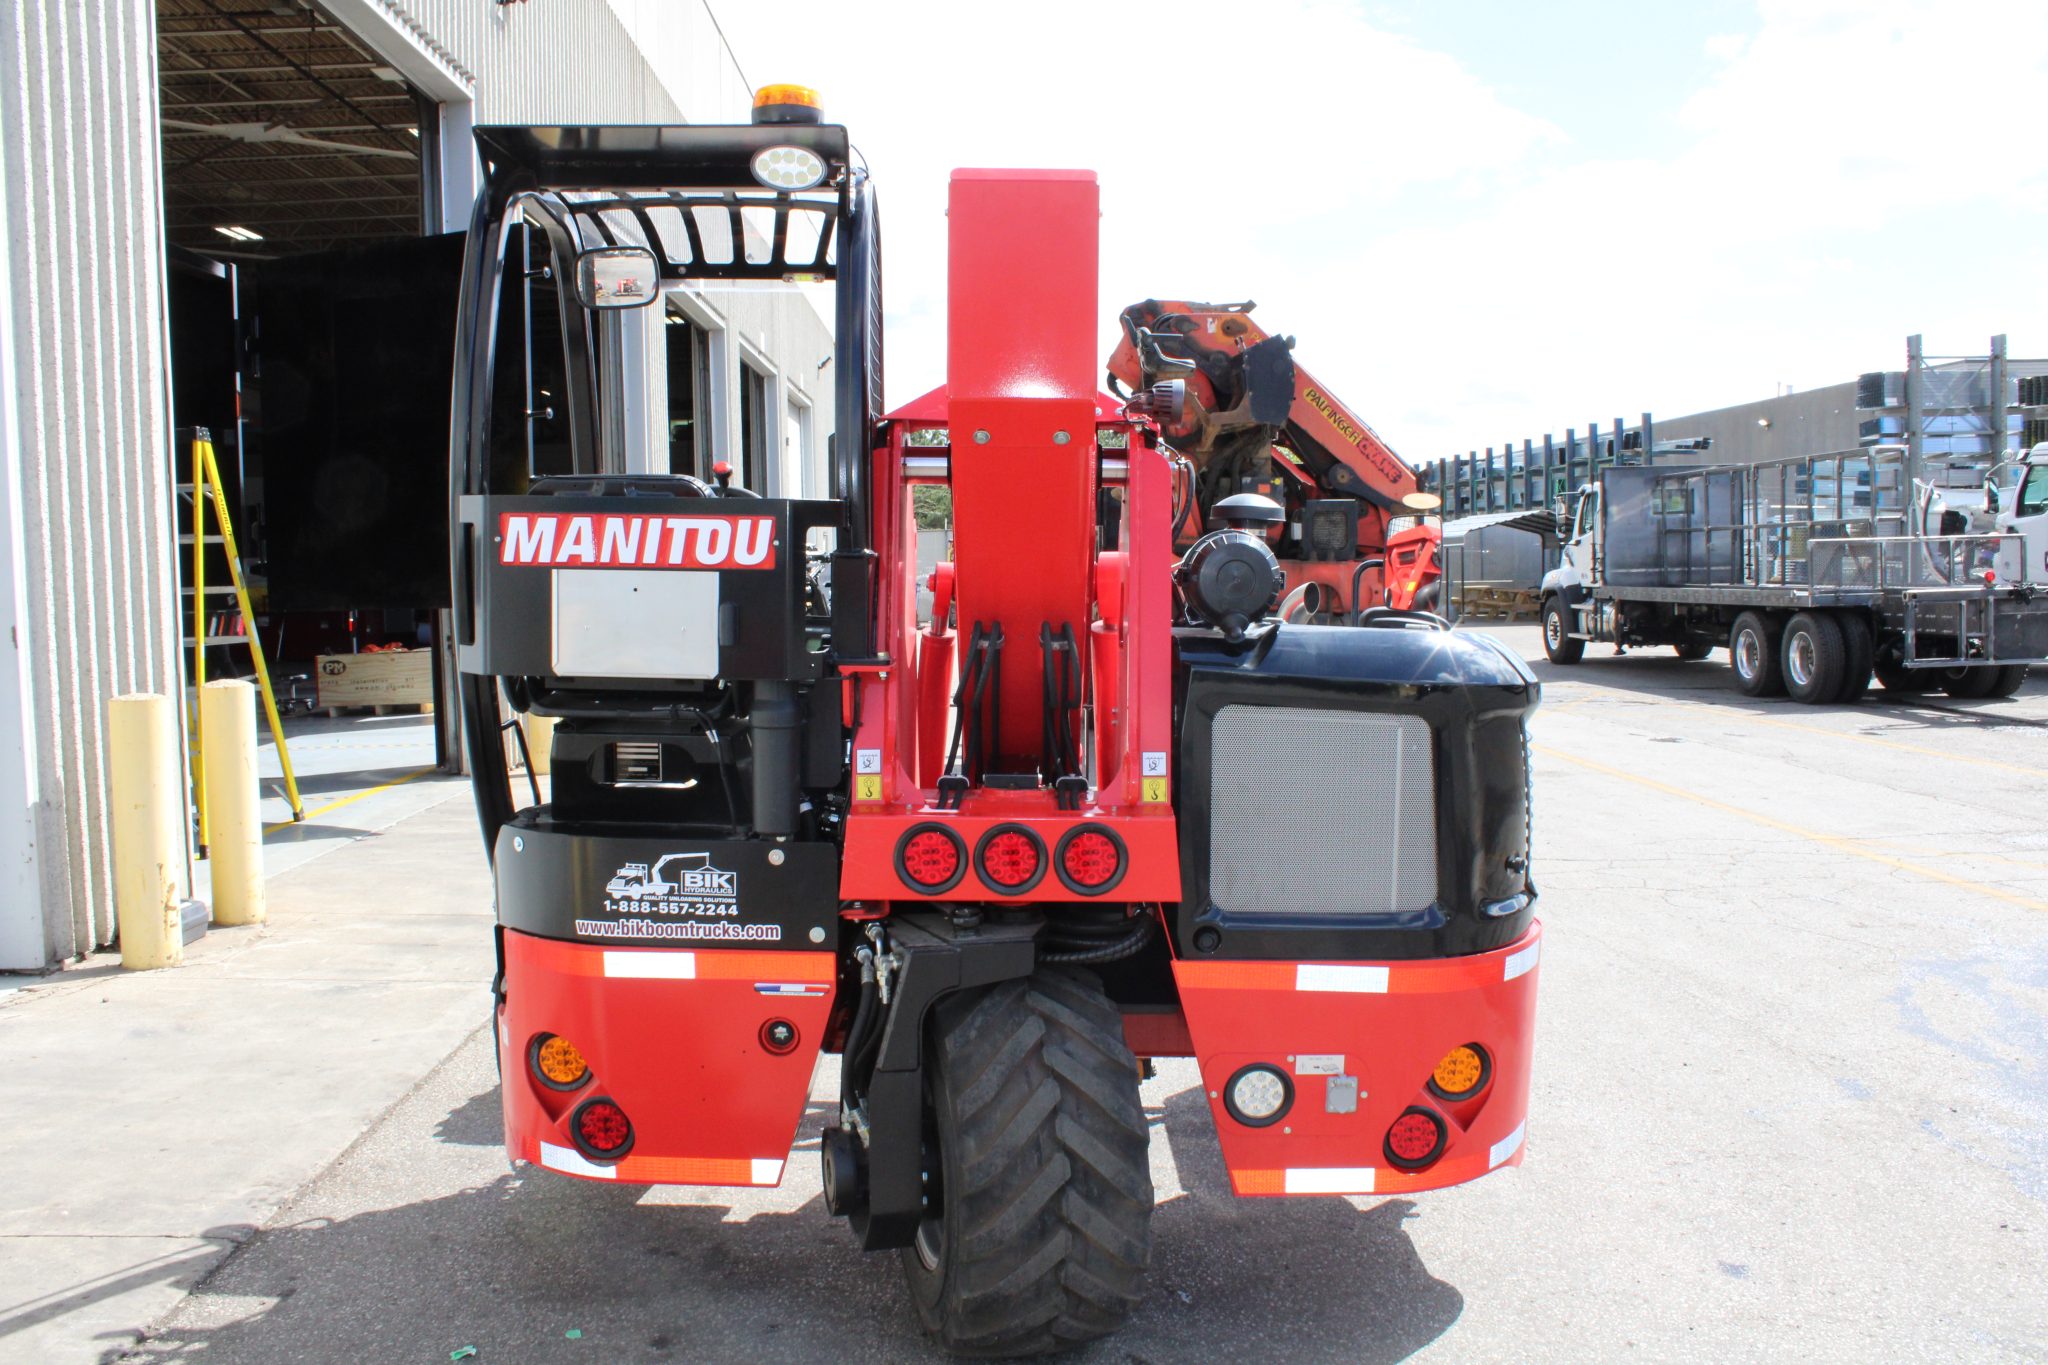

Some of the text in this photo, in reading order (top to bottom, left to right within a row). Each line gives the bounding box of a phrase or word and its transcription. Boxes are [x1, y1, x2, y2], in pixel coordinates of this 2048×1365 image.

[1305, 388, 1361, 446] PALFINGER
[503, 516, 773, 565] MANITOU
[325, 662, 345, 673] PM
[685, 873, 732, 888] BIK
[603, 900, 739, 916] 1-888-557-2244
[576, 919, 781, 940] www.bikboomtrucks.com
